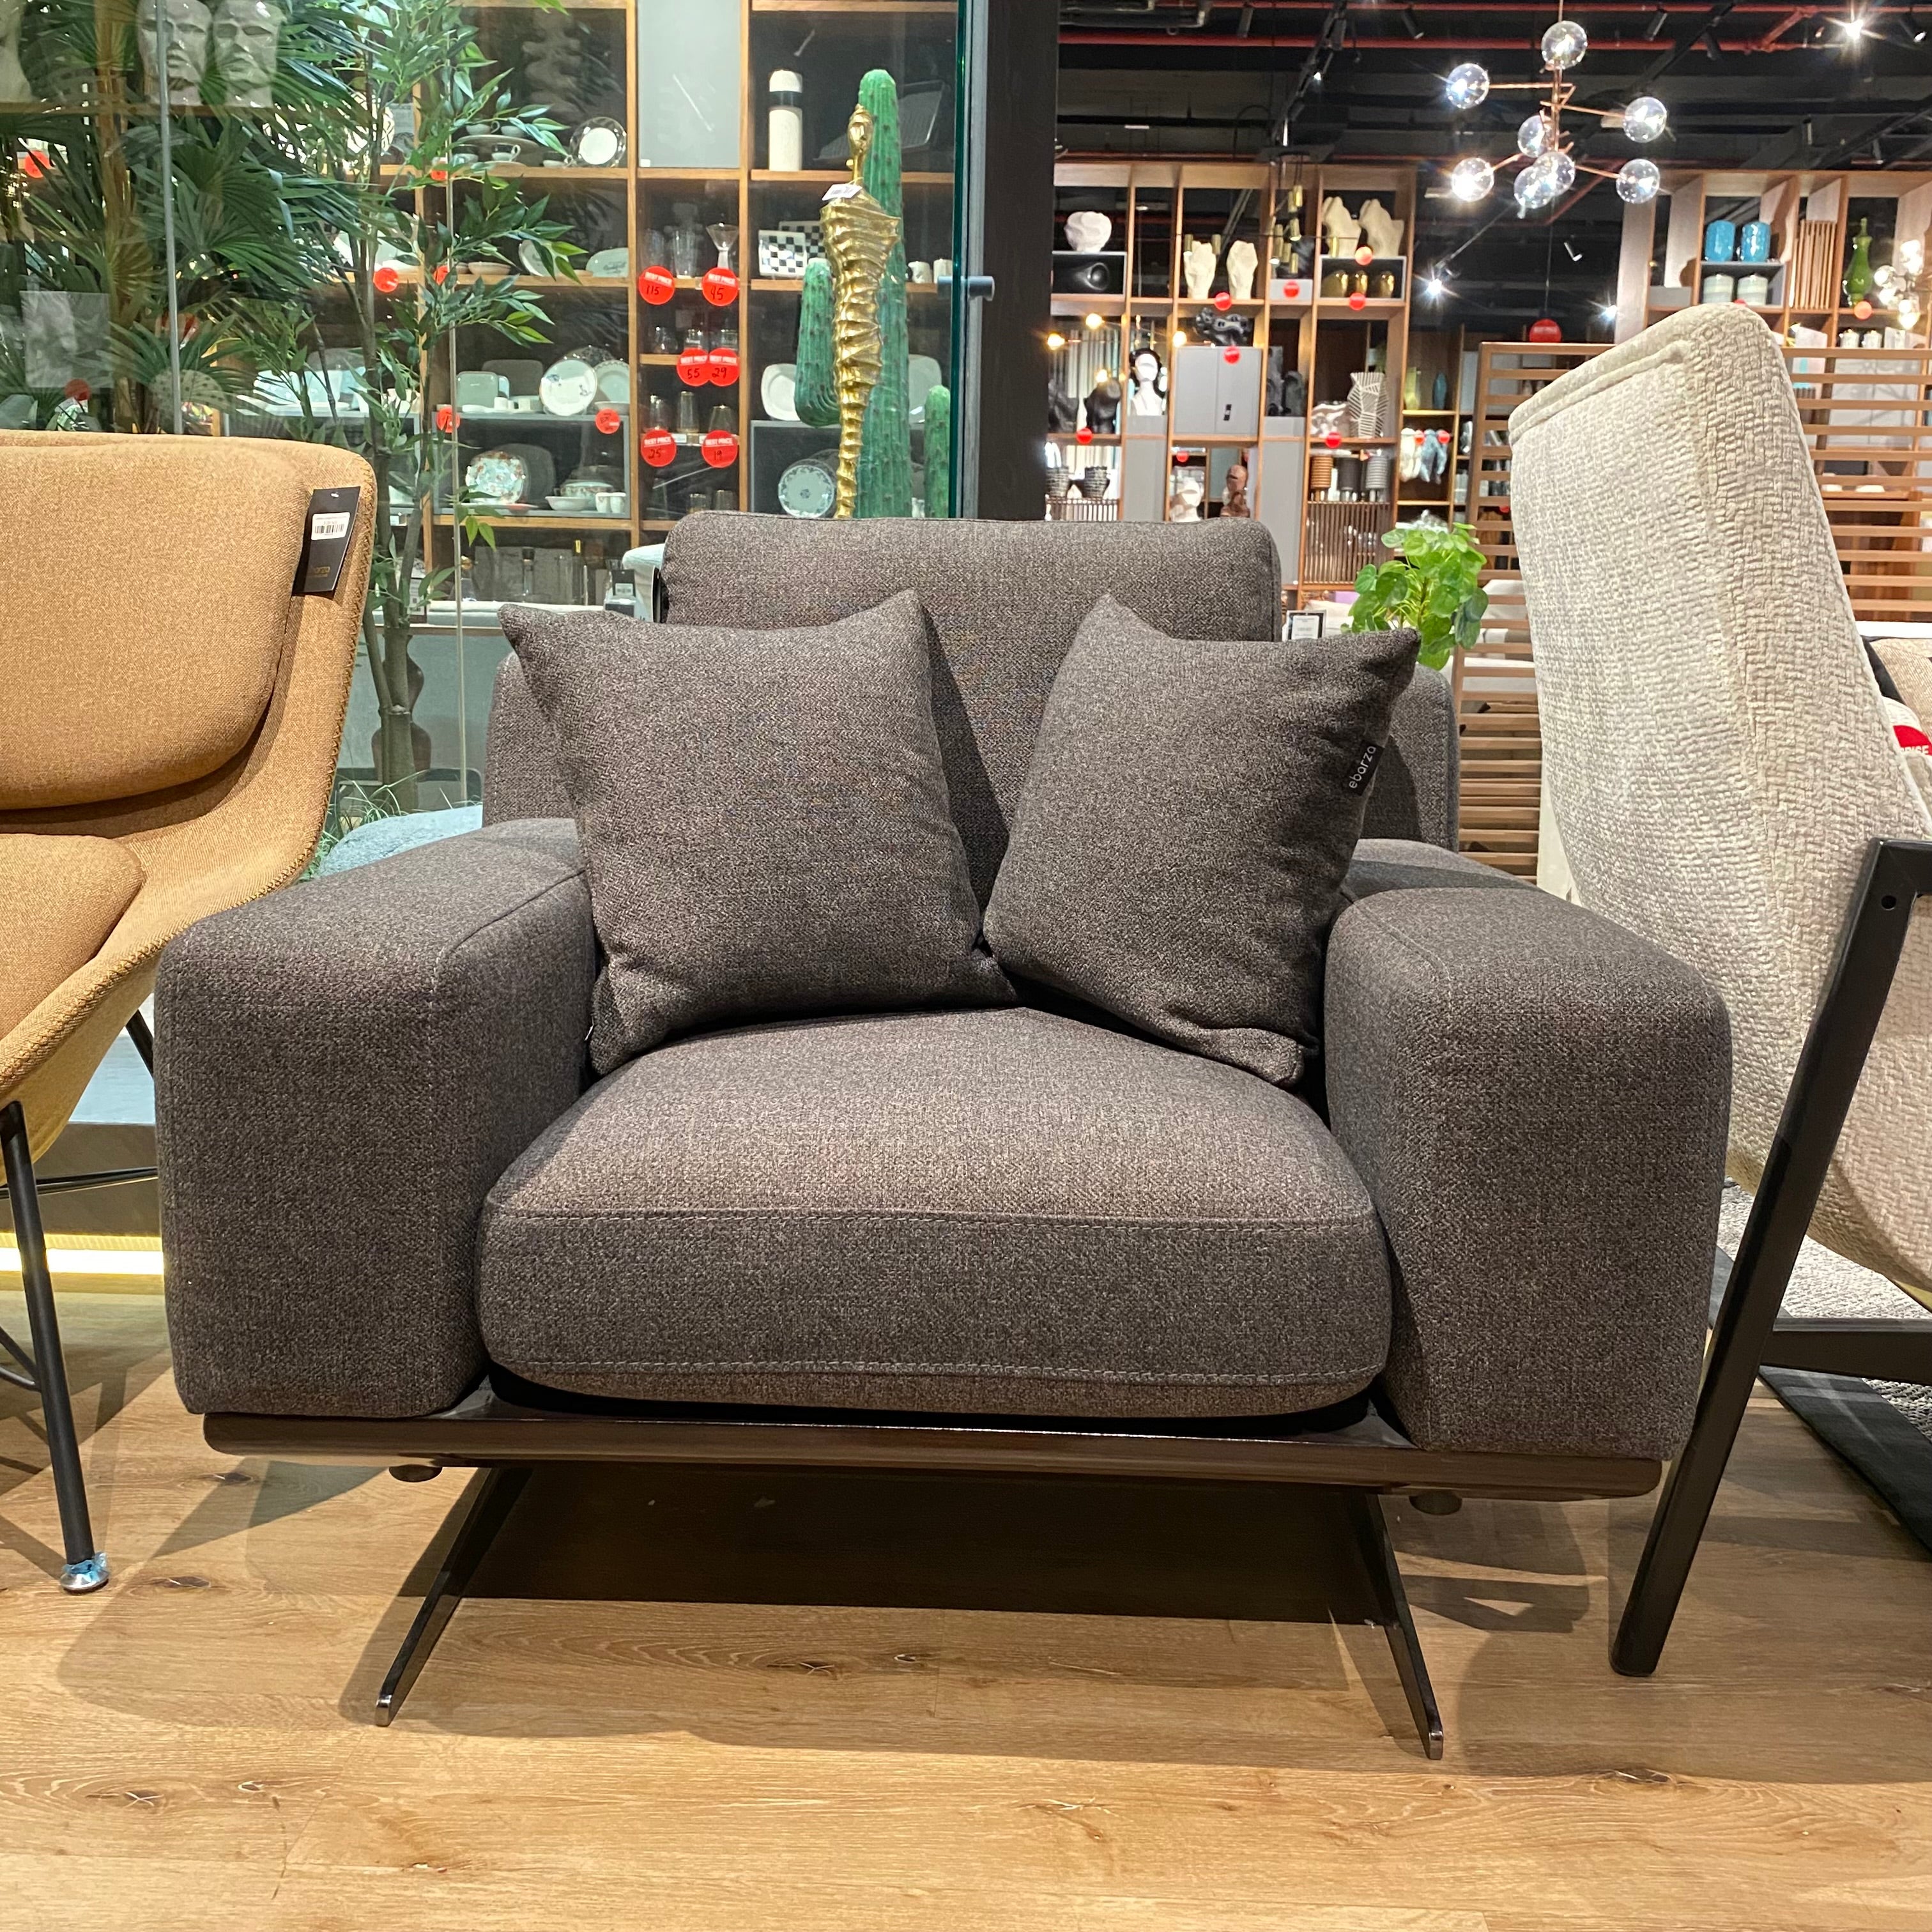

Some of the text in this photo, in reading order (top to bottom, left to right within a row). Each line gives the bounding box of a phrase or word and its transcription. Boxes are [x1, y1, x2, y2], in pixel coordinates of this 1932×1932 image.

[708, 273, 735, 286] BEST PRICE
[687, 368, 700, 379] 55
[1349, 746, 1377, 788] ebarza
